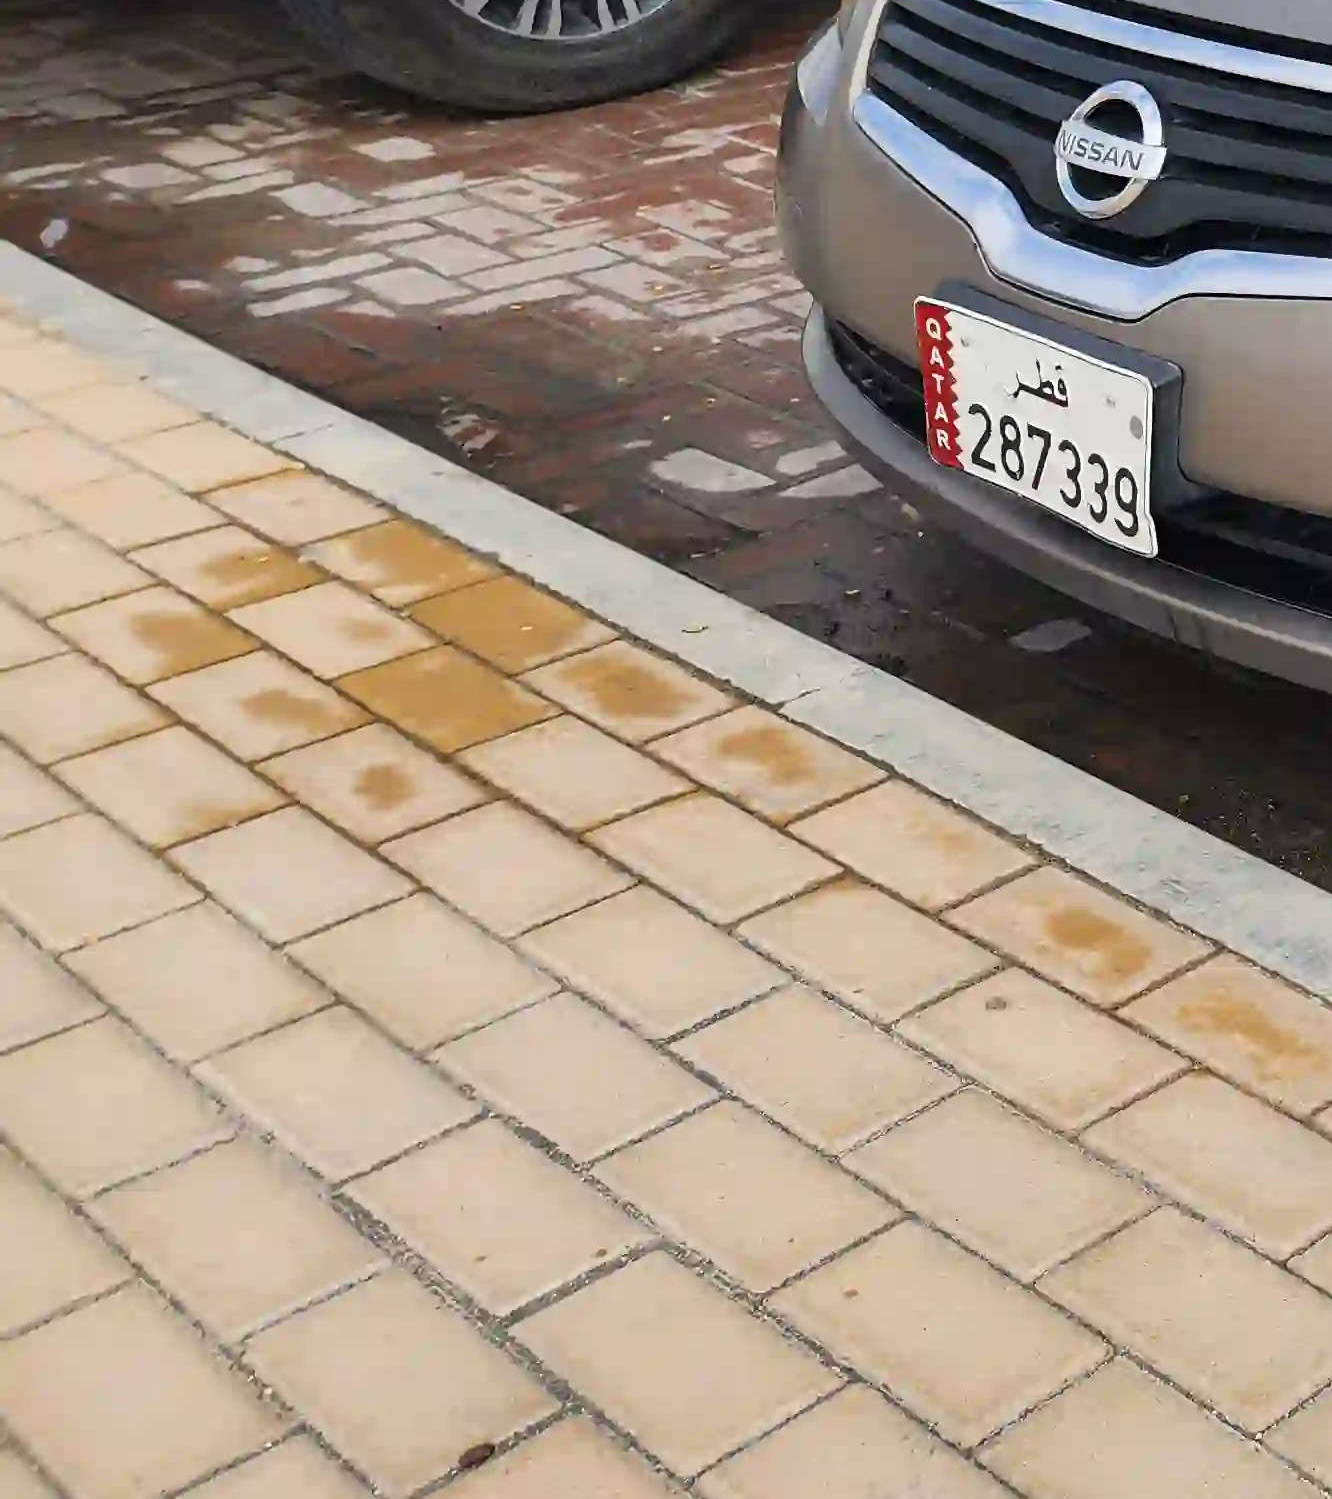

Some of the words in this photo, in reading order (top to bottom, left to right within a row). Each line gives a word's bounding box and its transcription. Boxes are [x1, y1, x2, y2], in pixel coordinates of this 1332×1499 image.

[1057, 129, 1145, 172] NISSAN
[924, 316, 952, 451] QATAR
[1006, 357, 1069, 408] قطر
[967, 403, 1139, 538] 287339
